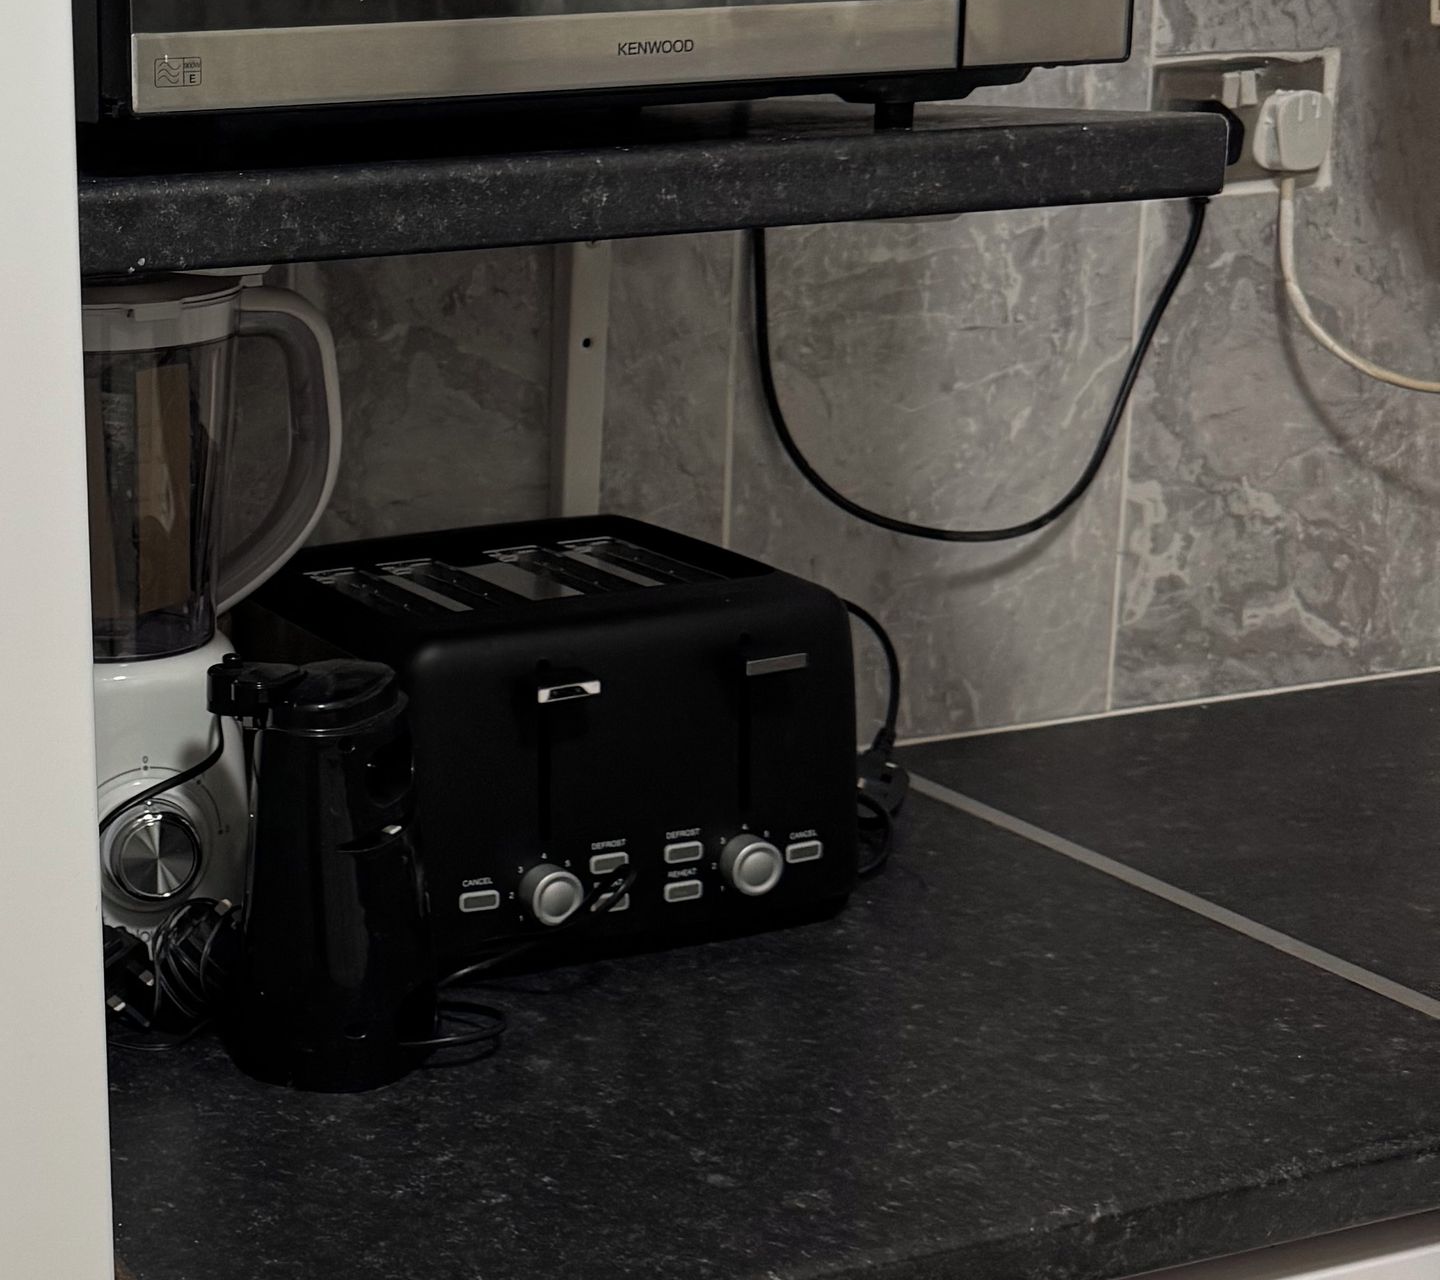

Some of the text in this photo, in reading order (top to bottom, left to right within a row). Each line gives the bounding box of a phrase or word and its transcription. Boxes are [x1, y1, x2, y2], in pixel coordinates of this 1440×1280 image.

[618, 39, 694, 56] KENWOOD
[189, 74, 196, 84] E
[665, 827, 701, 840] DEFROST
[789, 829, 817, 840] CANCEL
[591, 838, 627, 850] DEFROST
[518, 866, 524, 874] 3
[667, 867, 697, 878] REHEAT
[462, 877, 493, 888] CANCEL
